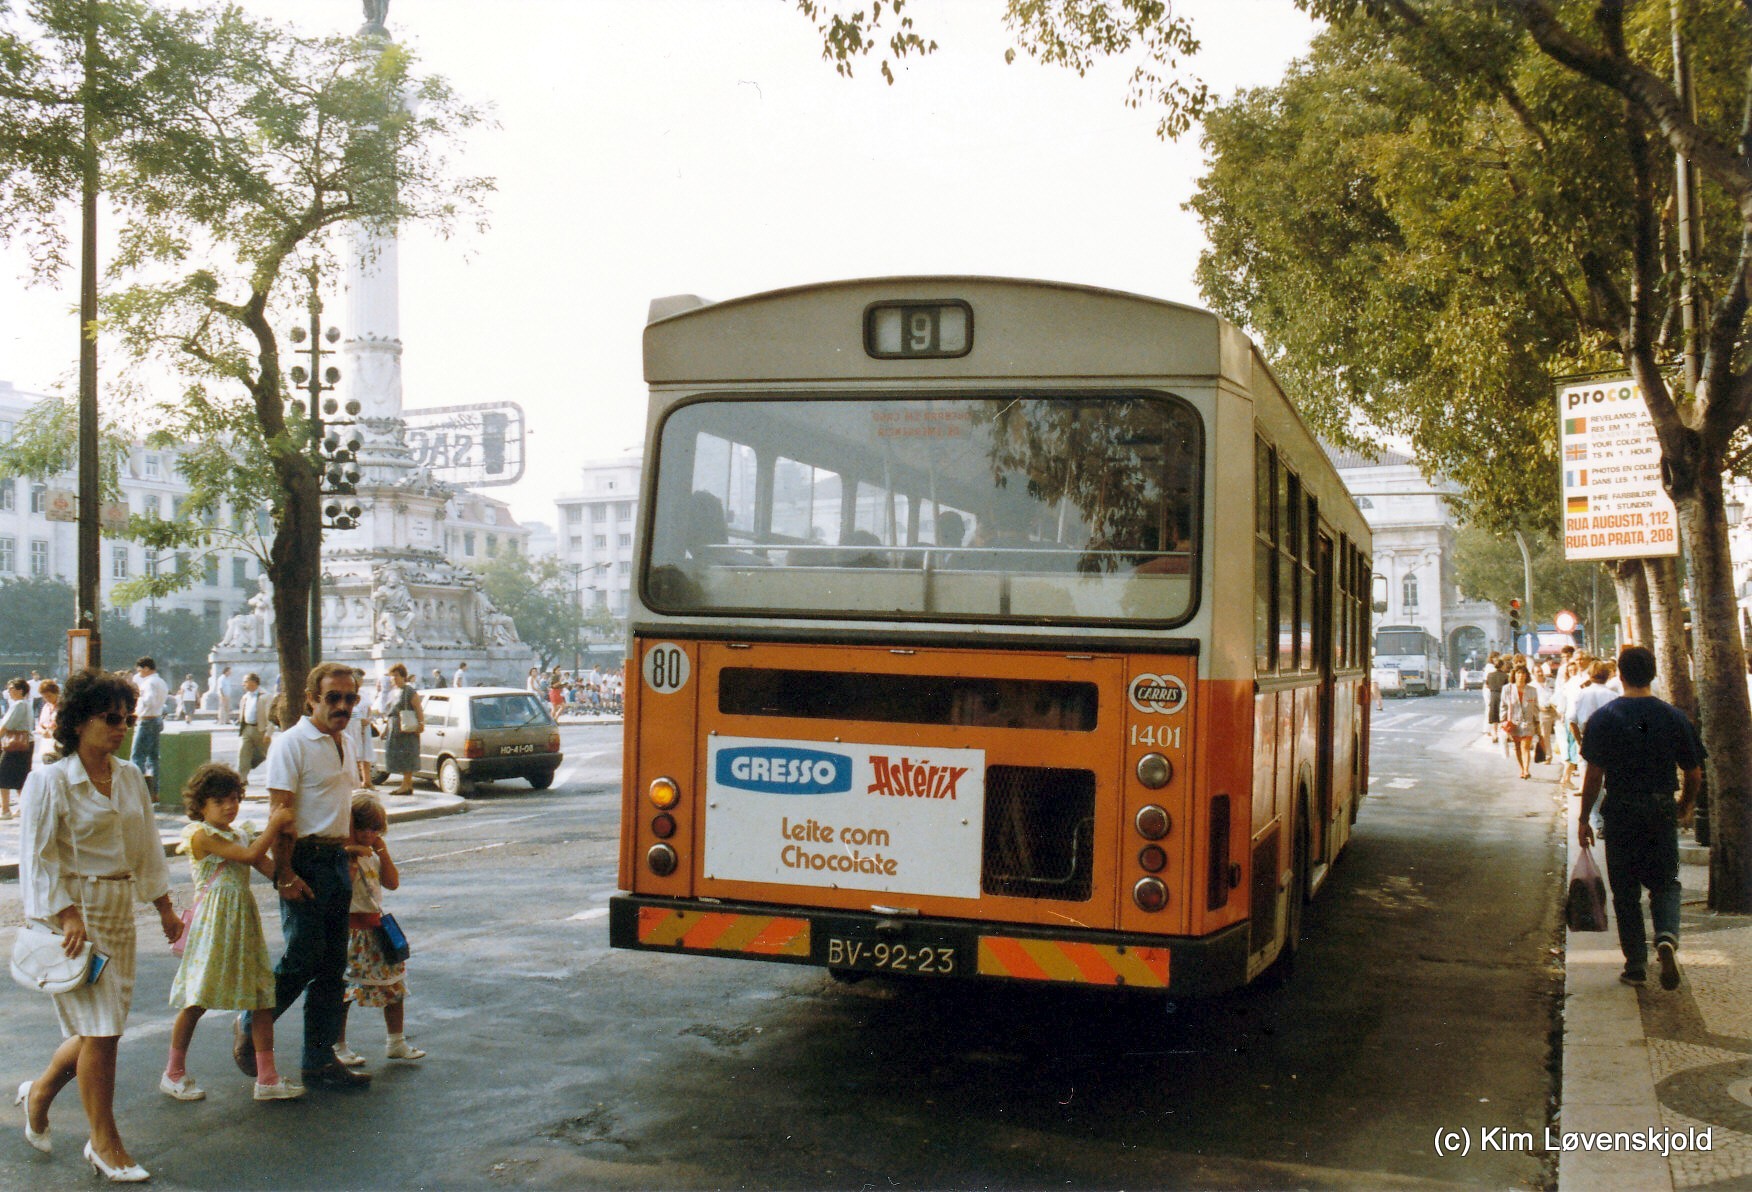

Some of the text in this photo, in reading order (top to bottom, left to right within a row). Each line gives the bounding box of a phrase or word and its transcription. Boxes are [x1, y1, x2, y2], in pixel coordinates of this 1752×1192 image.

[910, 312, 931, 350] 9
[1591, 412, 1637, 423] REVELAMOS
[1616, 438, 1641, 446] COLOR
[1617, 501, 1653, 510] STUNDEN
[1567, 517, 1589, 531] RUA
[1566, 535, 1588, 548] RUA
[1590, 533, 1606, 547] DA
[653, 648, 680, 688] 80
[1137, 687, 1179, 701] CARRIS
[1131, 724, 1181, 749] 1401
[730, 756, 836, 785] GRESSO
[867, 755, 969, 800] Astérix
[782, 817, 890, 847] Leite com
[781, 845, 898, 876] Chocolate
[828, 938, 955, 973] BV-92-23
